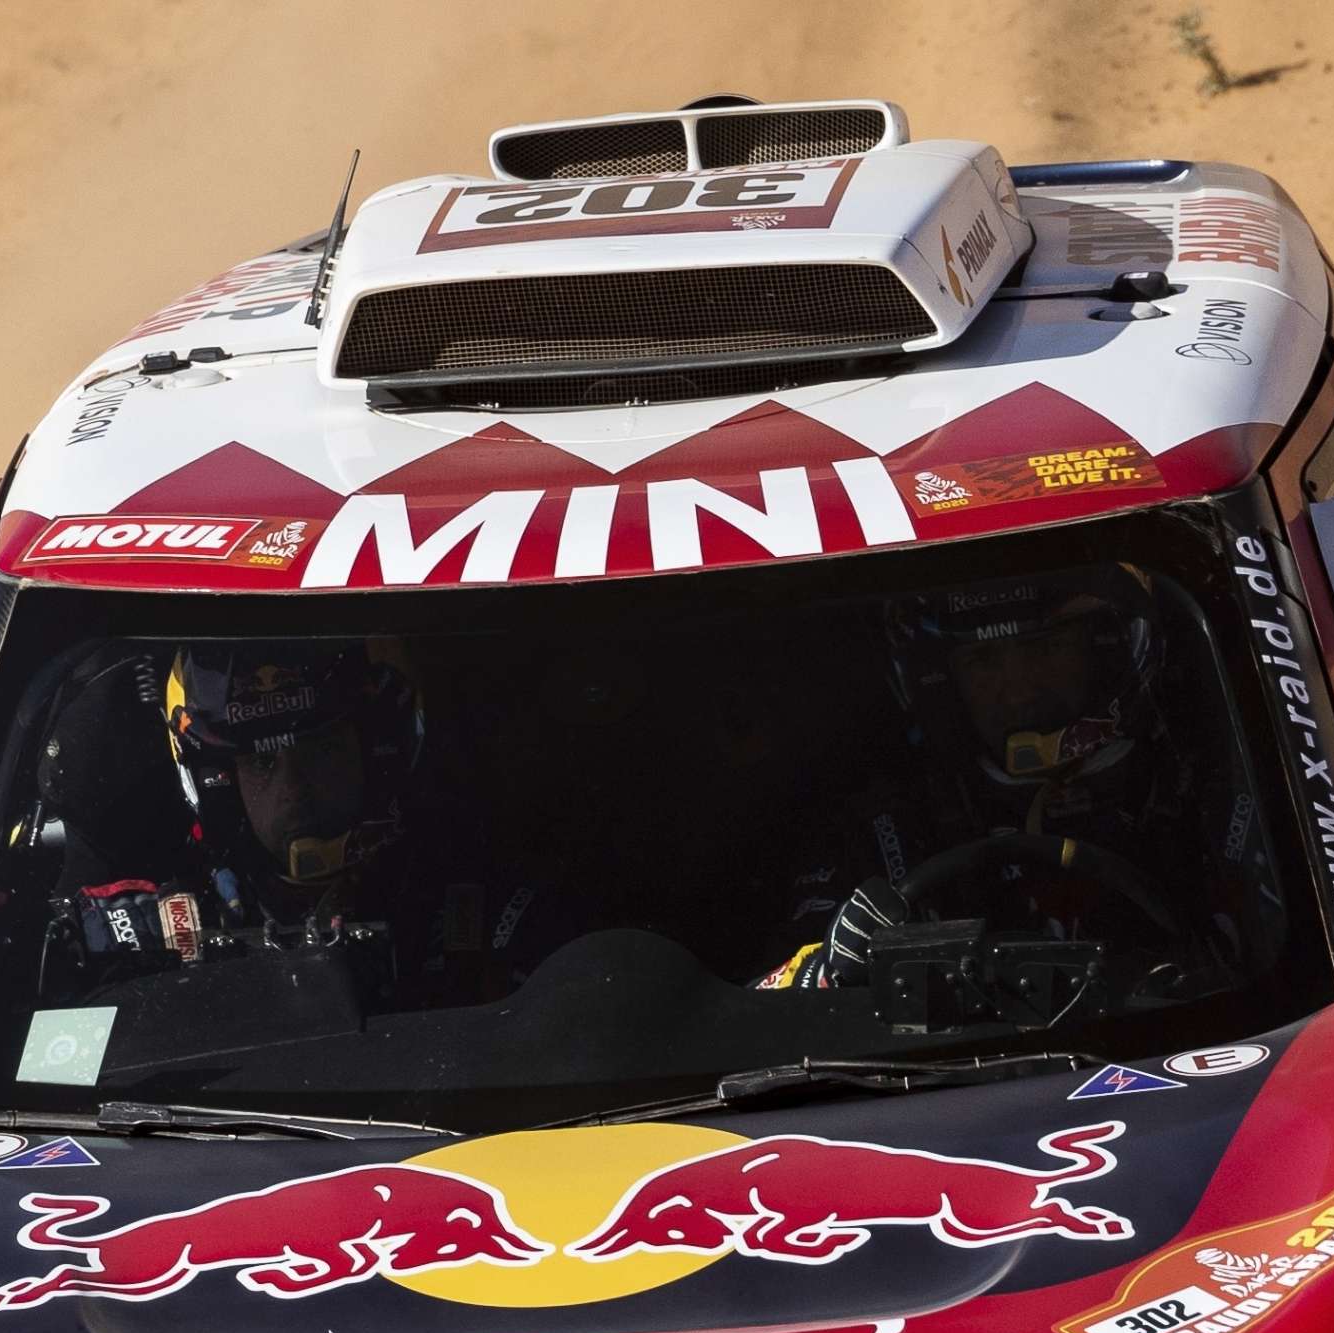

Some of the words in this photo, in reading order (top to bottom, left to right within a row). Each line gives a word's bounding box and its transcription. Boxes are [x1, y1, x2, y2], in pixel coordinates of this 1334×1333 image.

[476, 173, 805, 224] 302
[956, 209, 998, 283] PRIMAX
[1196, 299, 1248, 342] VISION
[66, 391, 127, 446] VISION
[1028, 446, 1136, 467] DREAM.
[1036, 458, 1118, 477] DARE.
[1043, 470, 1105, 488] LIVE
[1109, 467, 1142, 480] IT.
[915, 487, 973, 505] DAKAR
[932, 499, 970, 512] 2020
[300, 456, 917, 588] MINI
[42, 523, 238, 550] MOTUL
[250, 540, 298, 558] DAKAR
[248, 555, 284, 565] 2020
[975, 621, 1018, 641] MINI
[227, 700, 271, 726] Red
[270, 686, 316, 715] Bull
[253, 732, 295, 753] MINI
[1192, 1049, 1242, 1071] E
[1219, 1253, 1302, 1298] DAKAR
